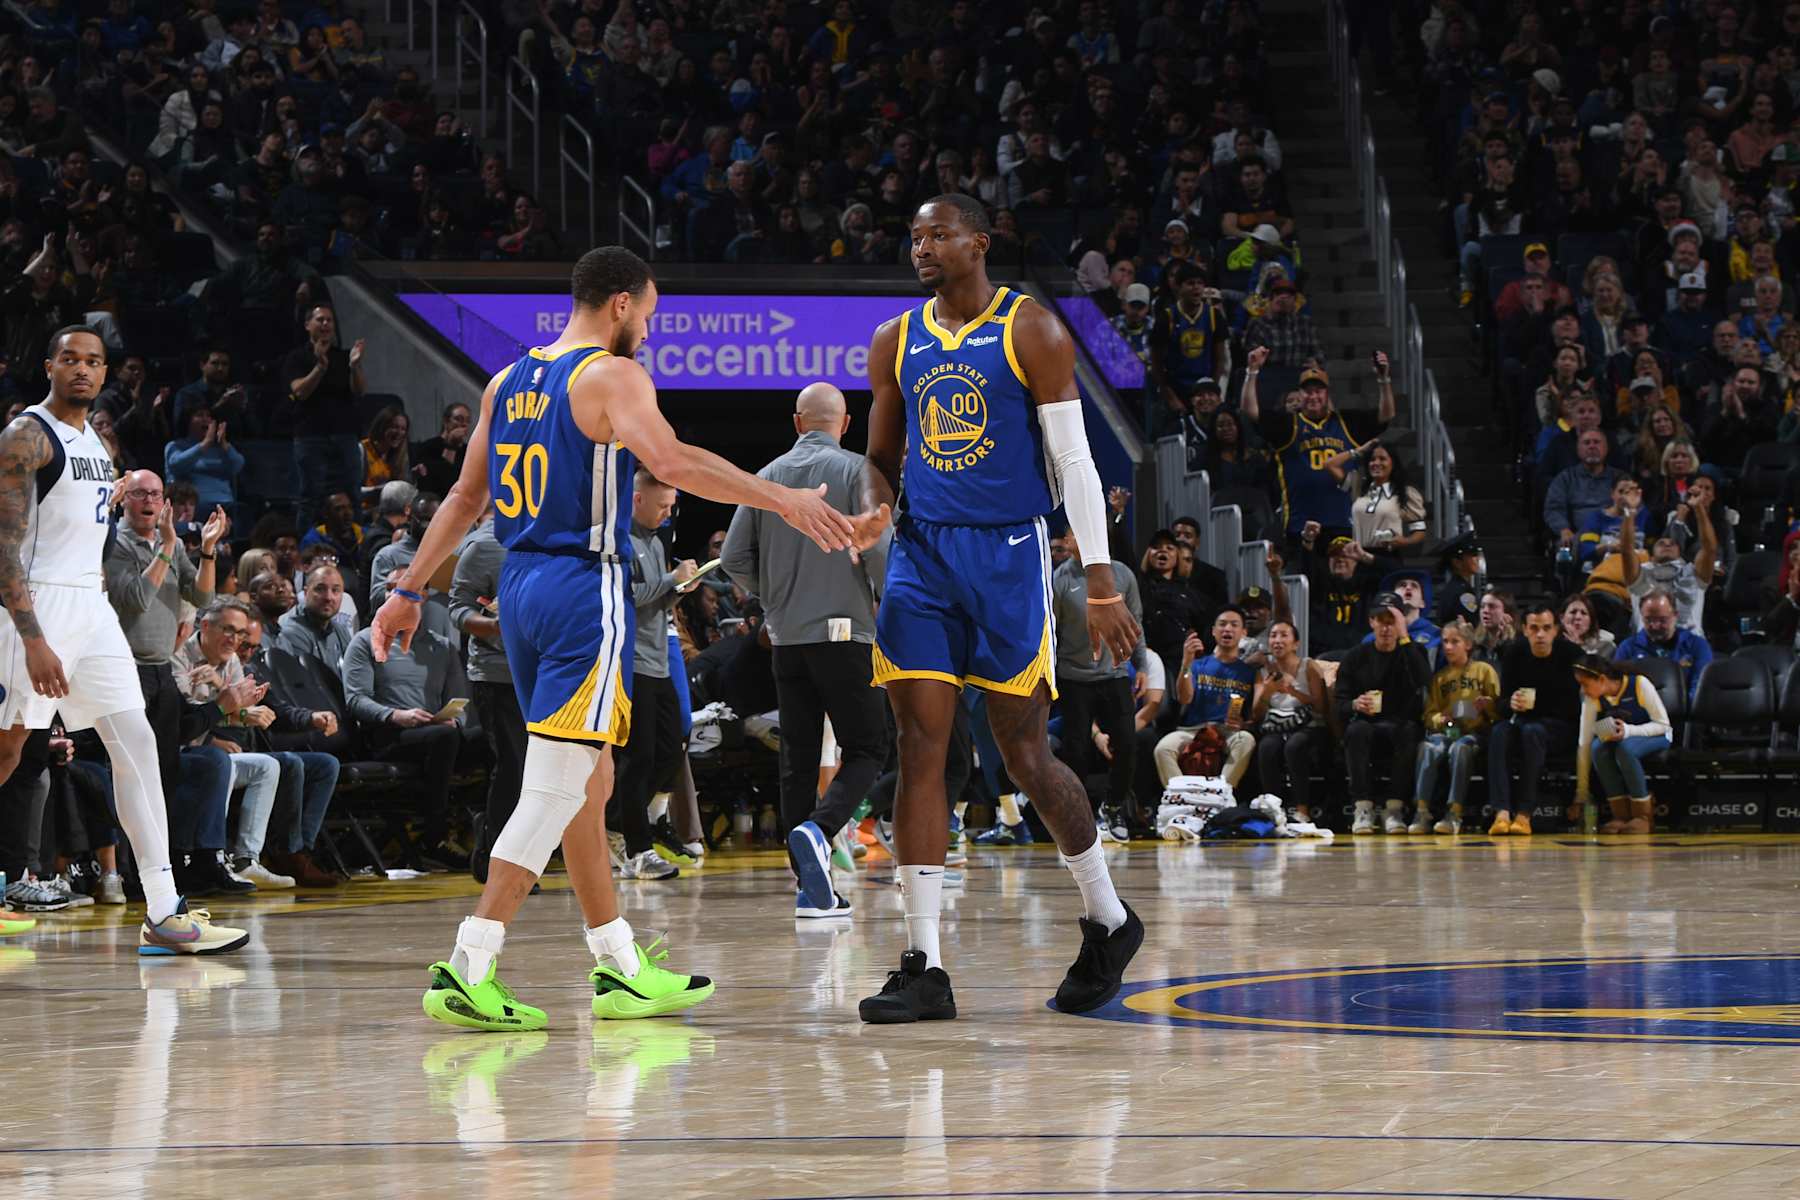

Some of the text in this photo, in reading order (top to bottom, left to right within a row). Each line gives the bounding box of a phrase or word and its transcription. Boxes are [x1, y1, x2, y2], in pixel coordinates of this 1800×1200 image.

[699, 313, 762, 334] WITH
[967, 336, 998, 347] Rakuten
[634, 337, 868, 377] accenture
[913, 362, 988, 394] GOLDEN STATE
[951, 392, 979, 416] 00
[920, 437, 995, 472] WARRIORS
[495, 443, 548, 519] 30
[1689, 803, 1741, 815] CHASE
